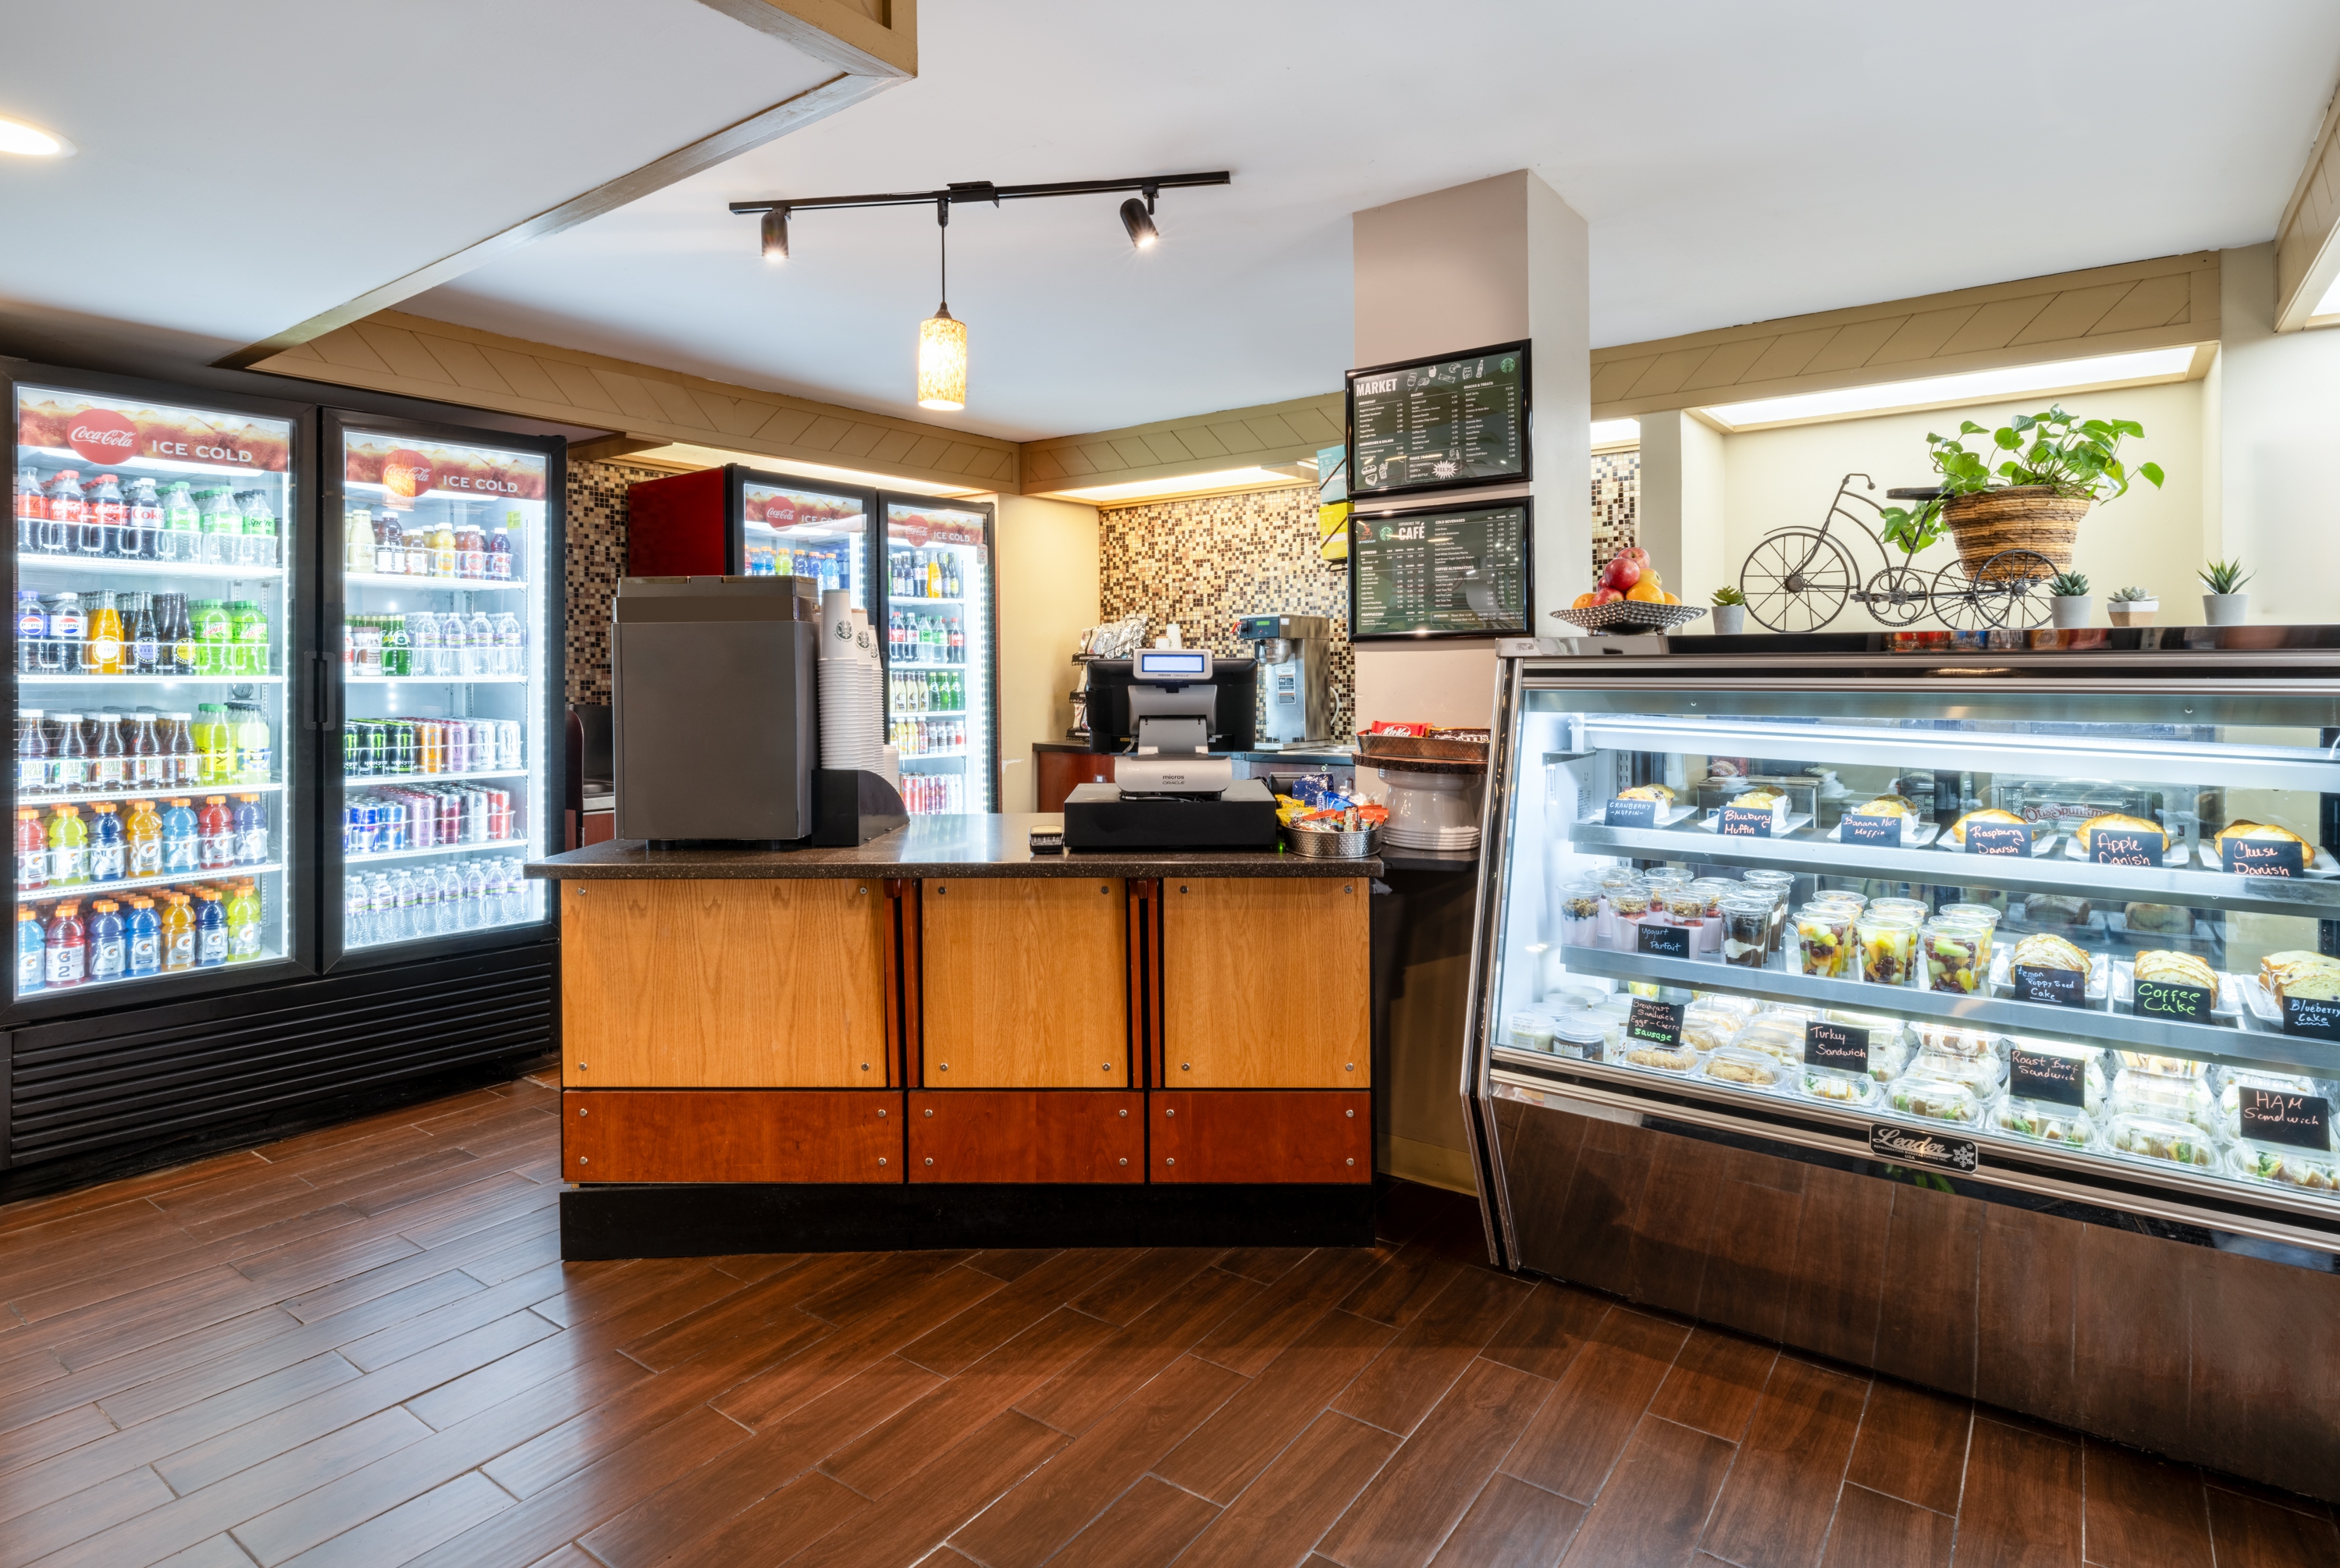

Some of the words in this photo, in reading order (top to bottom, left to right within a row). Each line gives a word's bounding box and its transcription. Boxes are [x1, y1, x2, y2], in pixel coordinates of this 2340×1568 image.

[1357, 379, 1397, 396] MARKET
[71, 426, 136, 448] Coca-Cola
[152, 440, 188, 456] ICE
[195, 445, 253, 463] COLD
[383, 464, 432, 482] Coca-Cola
[443, 475, 470, 488] ICE
[475, 478, 518, 493] COLD
[132, 508, 164, 521] Coke
[766, 507, 795, 520] Coca-Cola
[905, 525, 928, 536] Coca-Cola
[949, 533, 970, 542] COLD
[1399, 522, 1425, 540] CAFÉ
[1609, 802, 1652, 811] CRANBERRY
[1724, 809, 1771, 828] Blueberry
[1843, 816, 1879, 827] Banana
[1724, 823, 1755, 834] Muffin
[1854, 828, 1885, 837] Muffin
[1969, 826, 2025, 845] Raspberry
[1975, 842, 2018, 855] Danish
[2097, 833, 2143, 853] Apple
[2098, 851, 2151, 866] Danish
[2233, 862, 2290, 876] Danish
[1641, 927, 1669, 937] Yogurt
[1650, 940, 1681, 952] Parfait
[58, 965, 70, 978] 2
[2025, 978, 2052, 987] Poppy
[2030, 987, 2055, 1000] Cake
[2137, 983, 2201, 1003] Coffee
[1632, 999, 1670, 1013] Breakfast
[2144, 997, 2196, 1015] Cake
[1638, 1009, 1675, 1022] Sandwich
[2299, 1013, 2329, 1024] Cake
[1815, 1044, 1866, 1058] Sandwich
[2011, 1050, 2046, 1066] Roast
[2051, 1057, 2079, 1072] Beef
[2018, 1065, 2075, 1082] Sandwich
[2256, 1090, 2303, 1110] HAM
[2244, 1108, 2319, 1125] Sandwich
[1872, 1129, 1953, 1158] Leader
[1873, 1144, 1904, 1154] REFRIGERATION
[1904, 1150, 1939, 1161] MANUFACTURING
